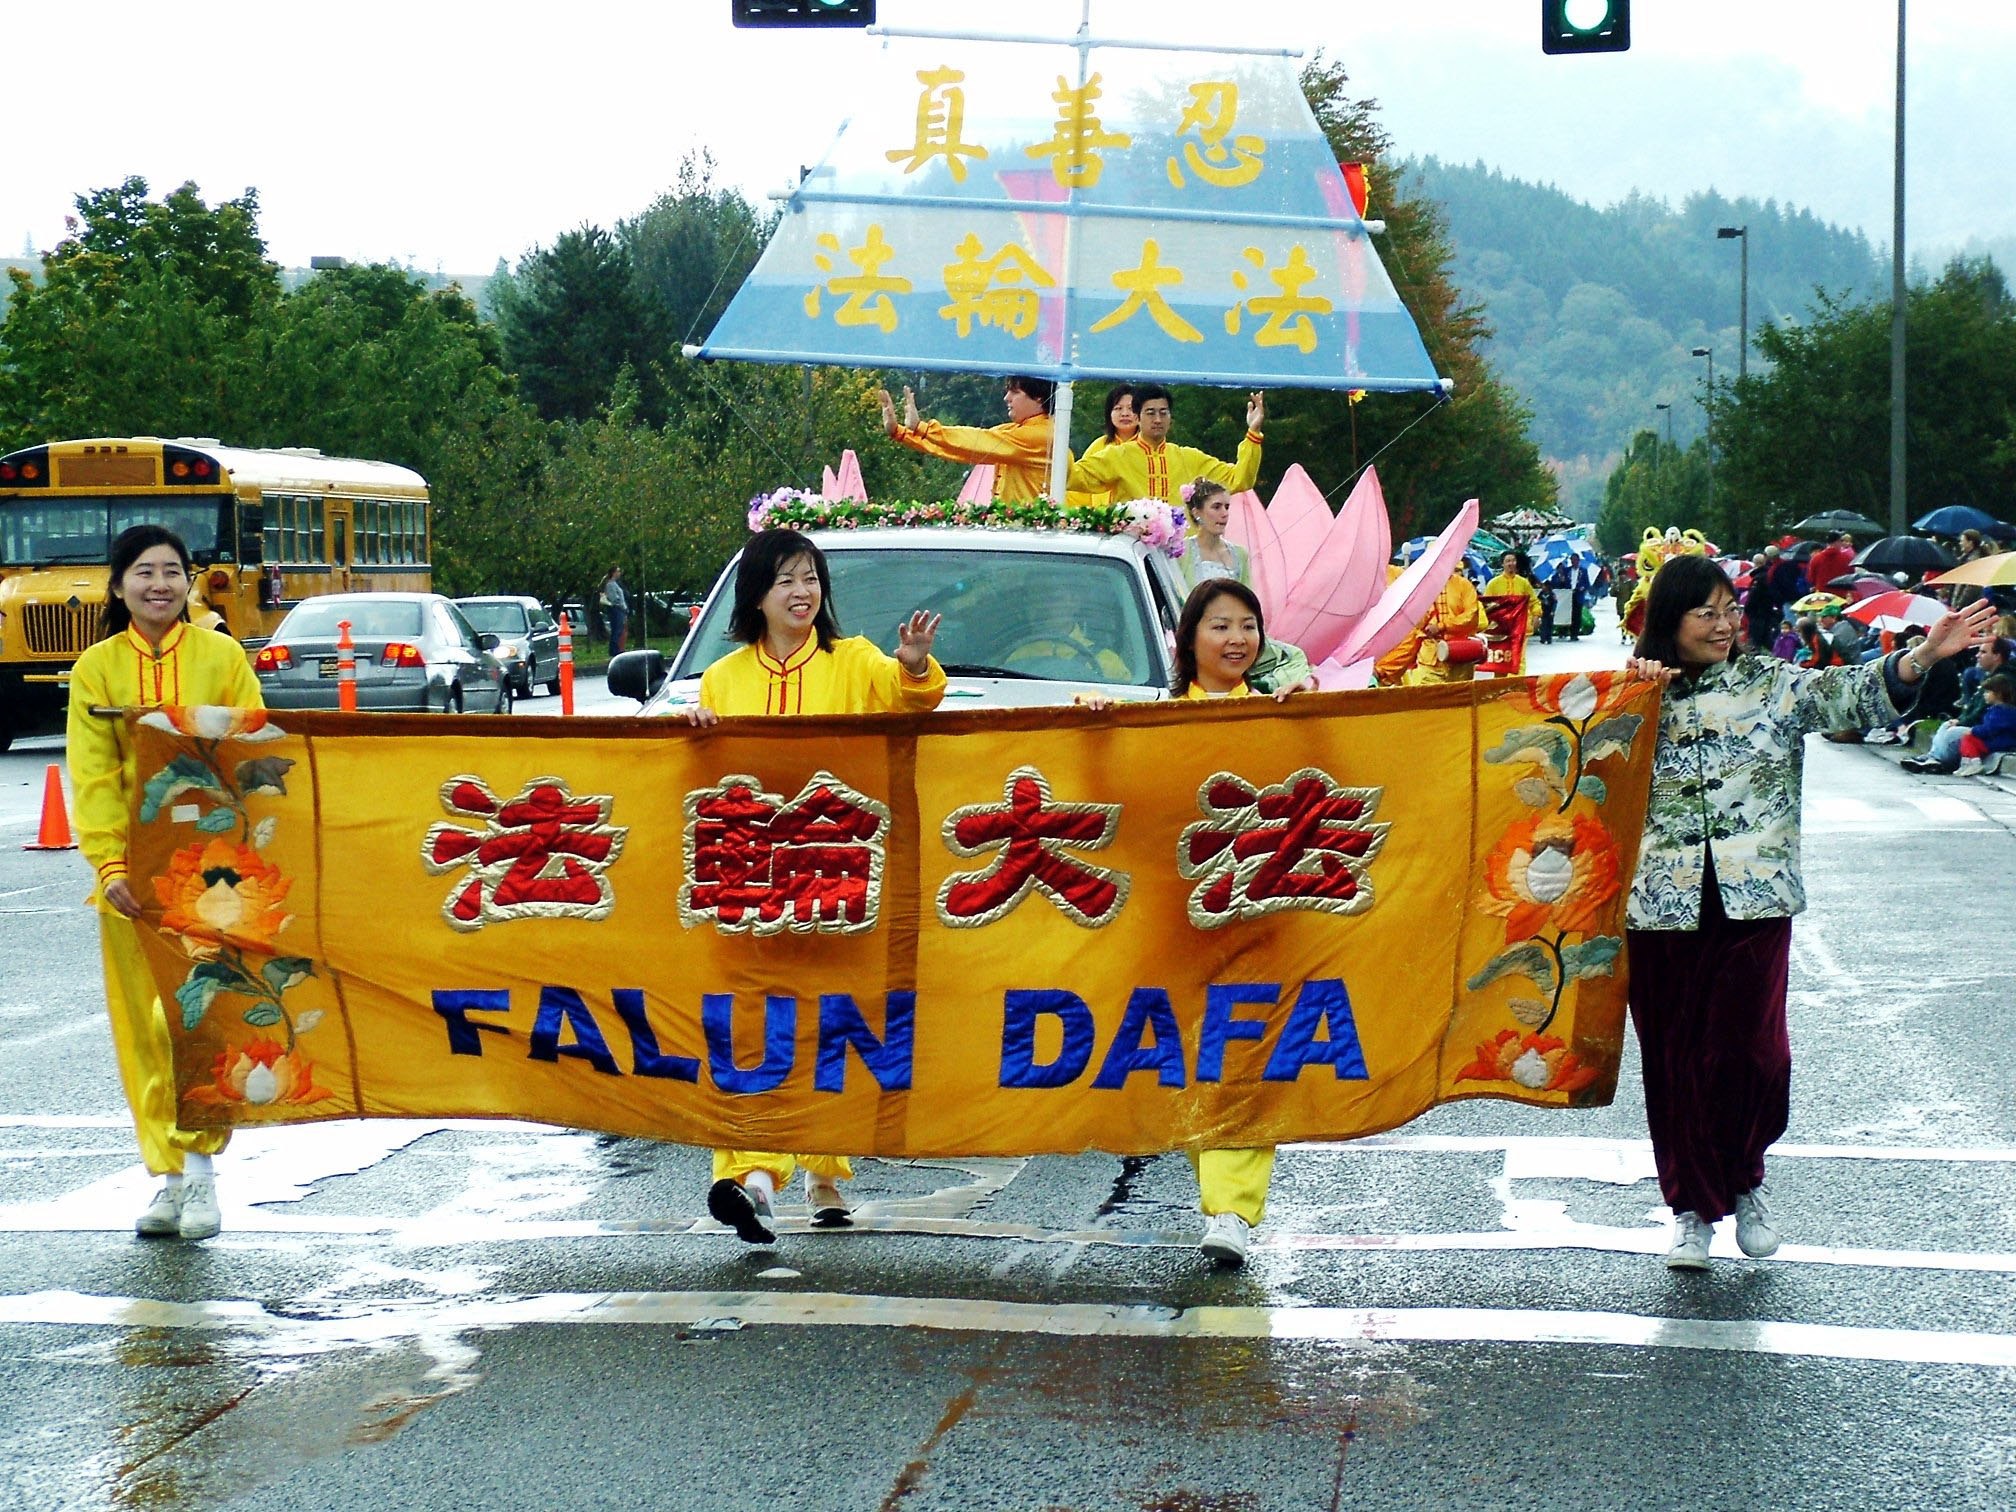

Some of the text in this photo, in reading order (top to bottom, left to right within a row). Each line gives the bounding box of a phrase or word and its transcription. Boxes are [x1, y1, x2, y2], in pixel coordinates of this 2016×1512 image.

[886, 66, 1266, 188] 真善忍
[804, 225, 1333, 354] 法輪大法
[421, 765, 1391, 935] 法輪大法
[431, 978, 1370, 1093] FALUN DAFA
